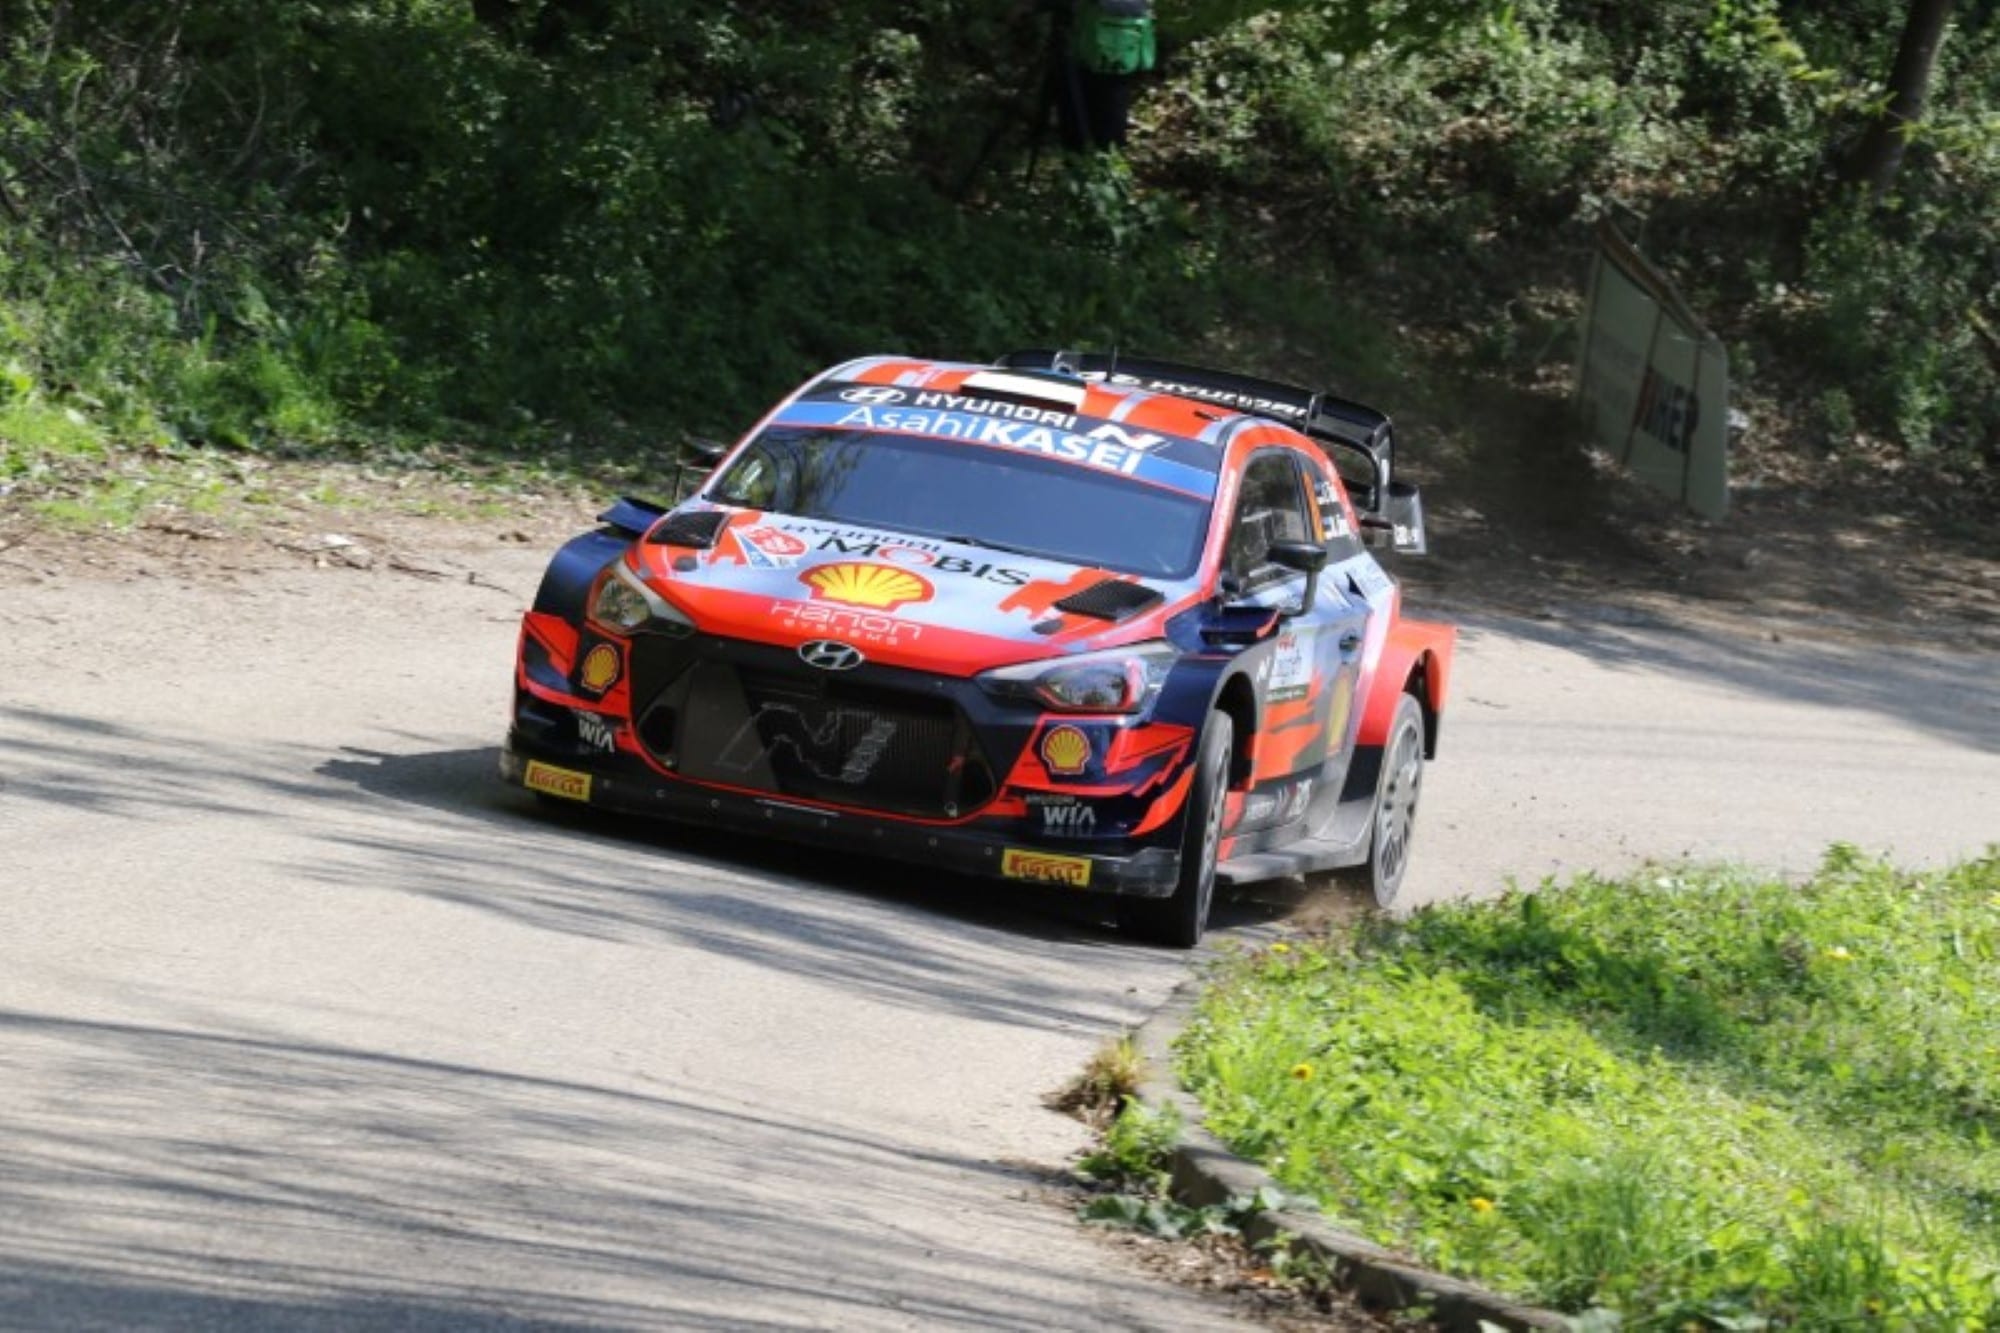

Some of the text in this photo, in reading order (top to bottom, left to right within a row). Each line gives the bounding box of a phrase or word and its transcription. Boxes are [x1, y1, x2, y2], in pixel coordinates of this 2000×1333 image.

[915, 390, 1078, 430] HYUNDAI
[782, 523, 942, 553] HYUNDAI
[816, 535, 1031, 586] MOBIS
[783, 617, 898, 646] SYSTEMS
[1043, 801, 1096, 827] WIA
[1008, 853, 1085, 882] PIRELLI
